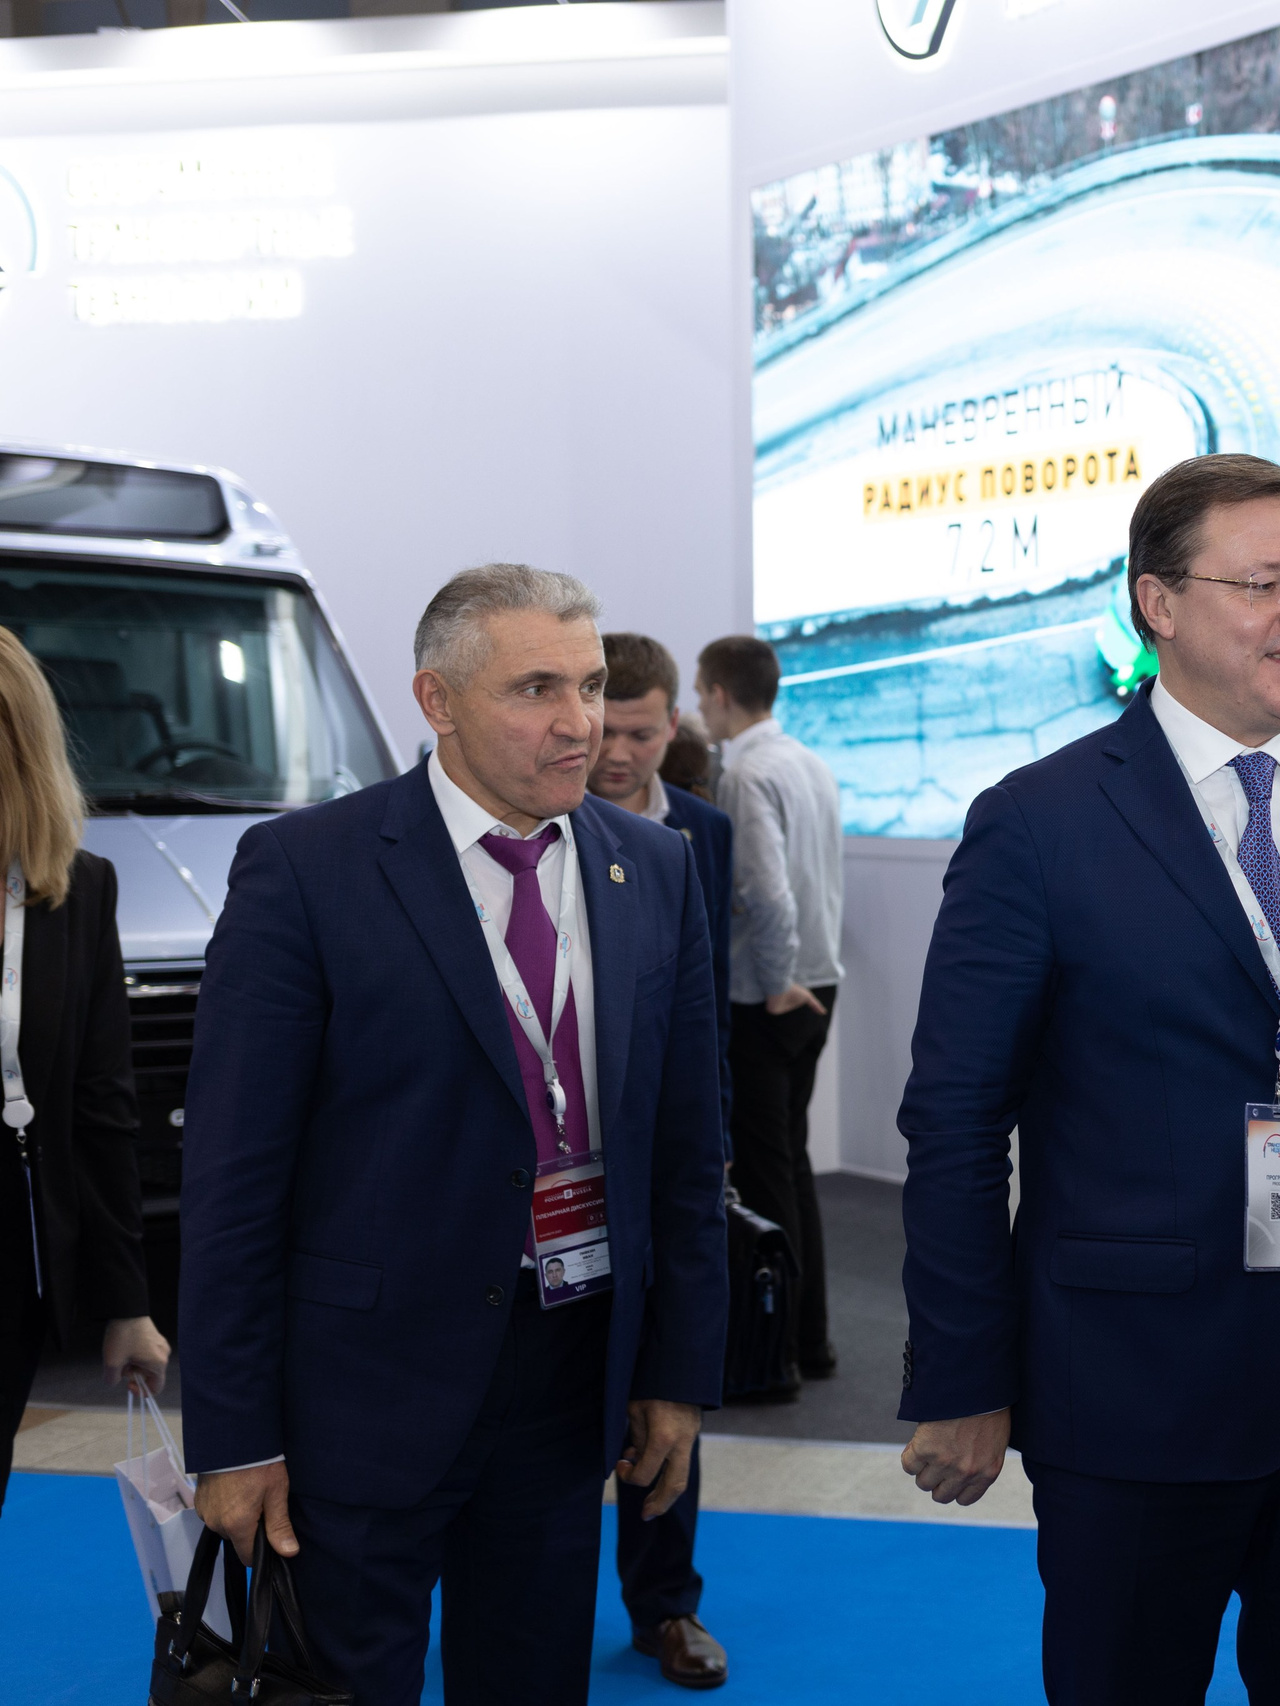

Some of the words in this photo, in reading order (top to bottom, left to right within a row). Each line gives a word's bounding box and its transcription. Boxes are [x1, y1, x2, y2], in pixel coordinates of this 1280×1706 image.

[876, 361, 1126, 450] МАНЕВРЕННЫЙ
[863, 470, 968, 516] РАДИУС
[980, 445, 1143, 501] ПОВОРОТА
[575, 1284, 587, 1292] VIP
